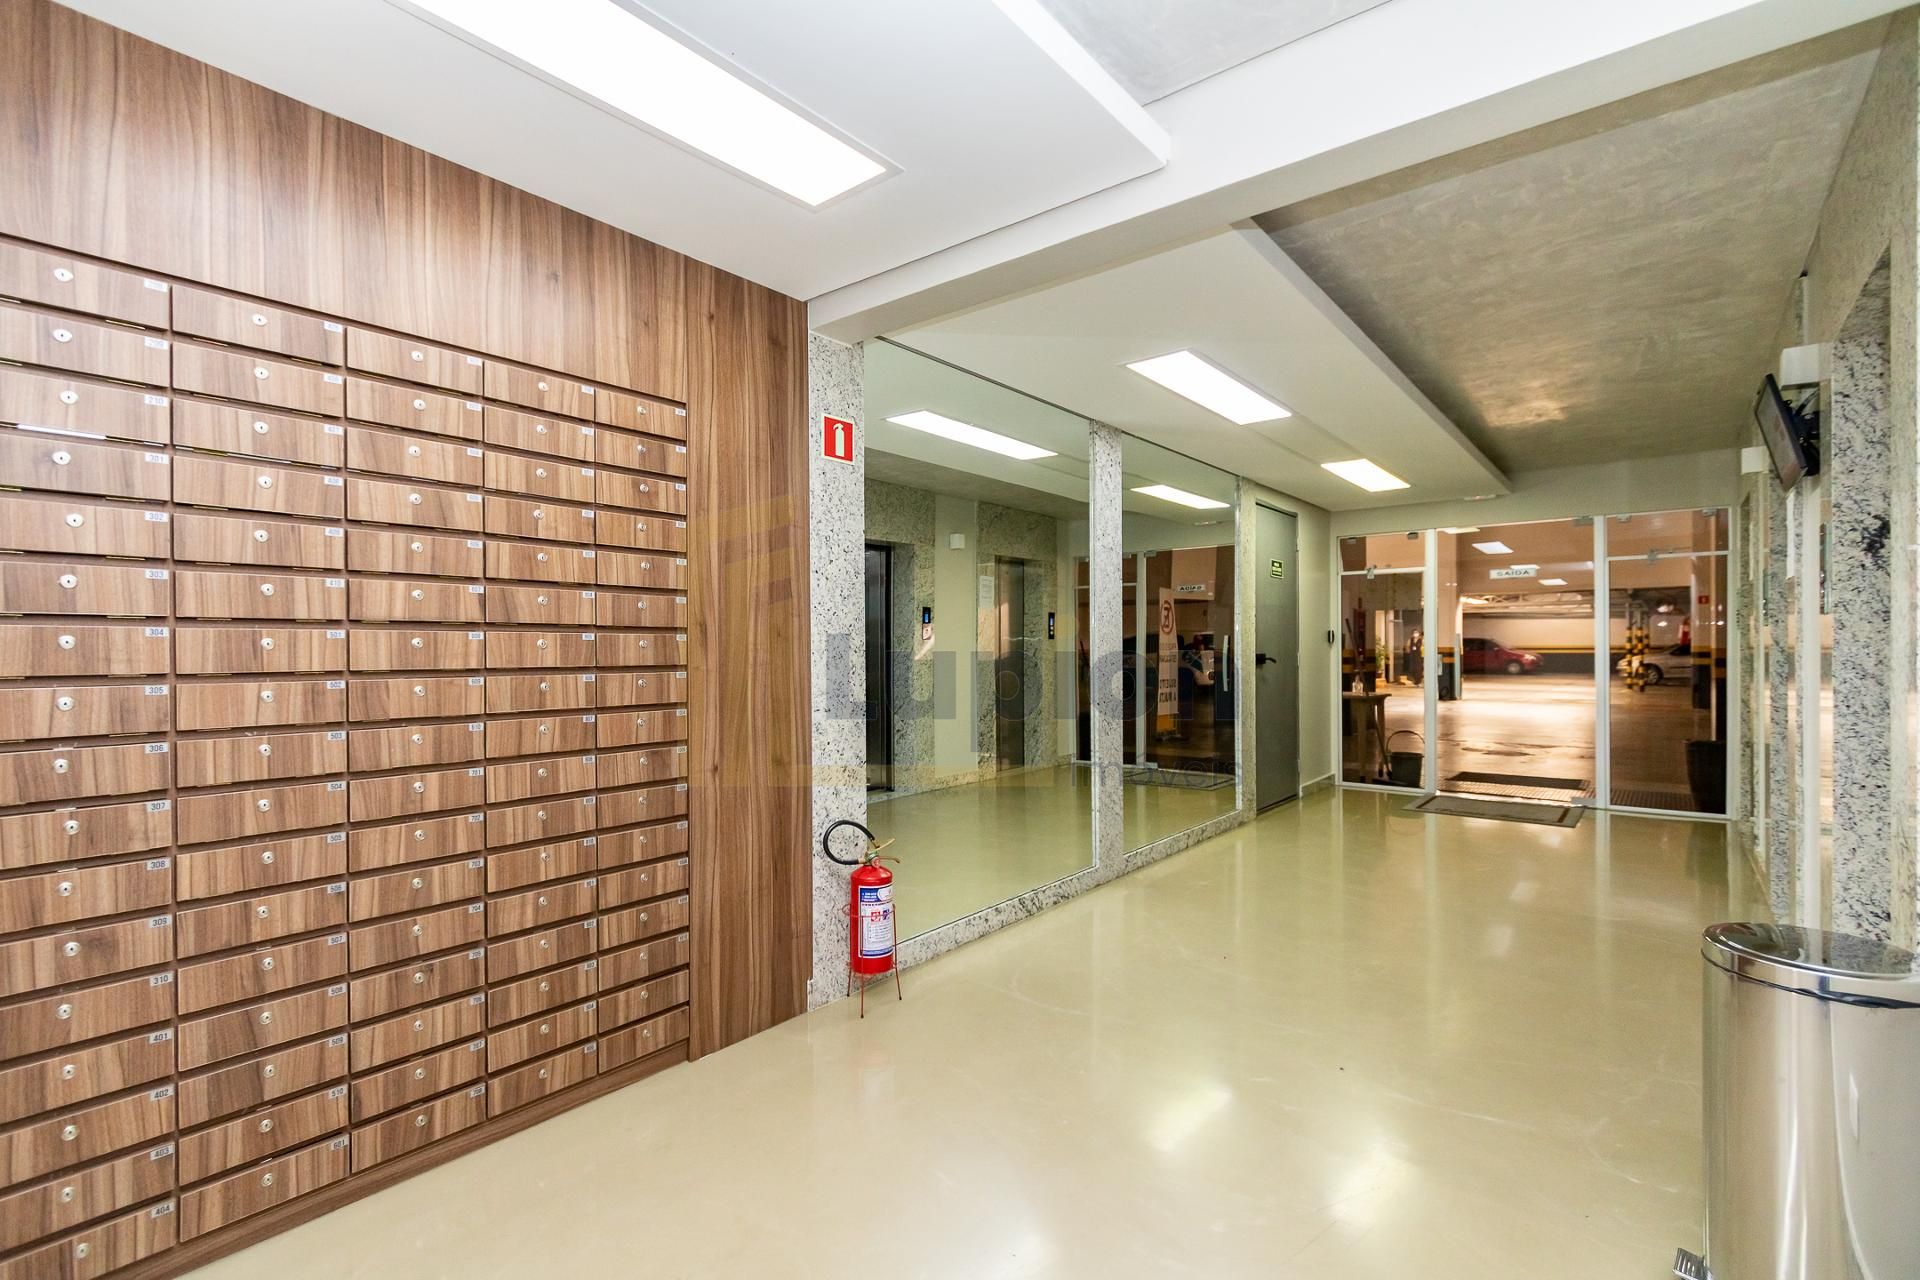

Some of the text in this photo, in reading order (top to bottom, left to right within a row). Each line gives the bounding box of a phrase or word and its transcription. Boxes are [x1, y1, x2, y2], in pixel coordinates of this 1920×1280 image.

[149, 512, 164, 521] 302
[149, 569, 164, 578] 303
[149, 628, 164, 636] 304
[149, 686, 164, 694] 305
[149, 744, 164, 752] 306
[151, 802, 166, 811] 307
[150, 860, 166, 869] 308
[152, 917, 167, 927] 309
[331, 936, 343, 944] 507
[154, 975, 169, 985] 310
[153, 1032, 168, 1041] 401
[154, 1089, 169, 1099] 402
[331, 1088, 344, 1097] 510
[154, 1147, 170, 1158] 403
[155, 1205, 170, 1215] 404
